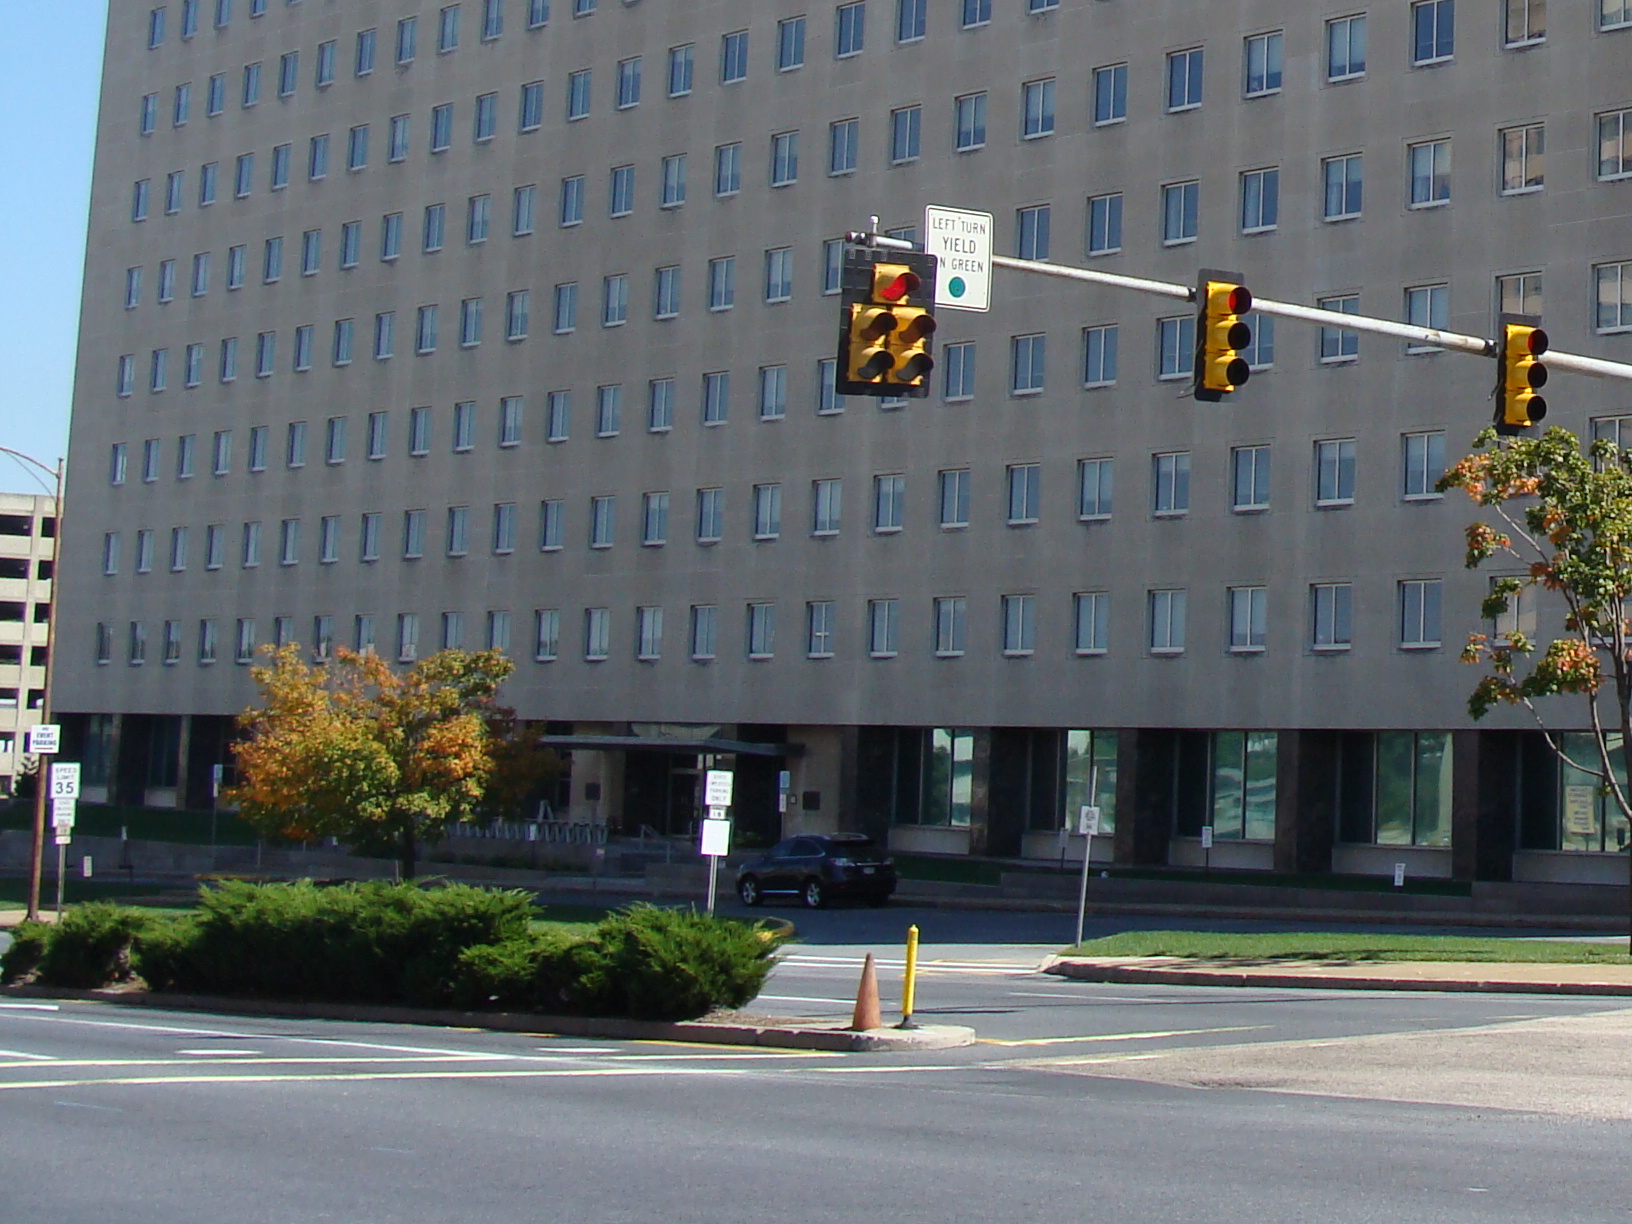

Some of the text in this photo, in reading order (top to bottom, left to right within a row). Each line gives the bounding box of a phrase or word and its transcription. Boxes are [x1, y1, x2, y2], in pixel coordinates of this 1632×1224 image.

[932, 216, 986, 235] LEFT TURN
[942, 236, 977, 254] YIELD
[939, 256, 984, 273] N GREEN
[55, 781, 74, 794] 35
